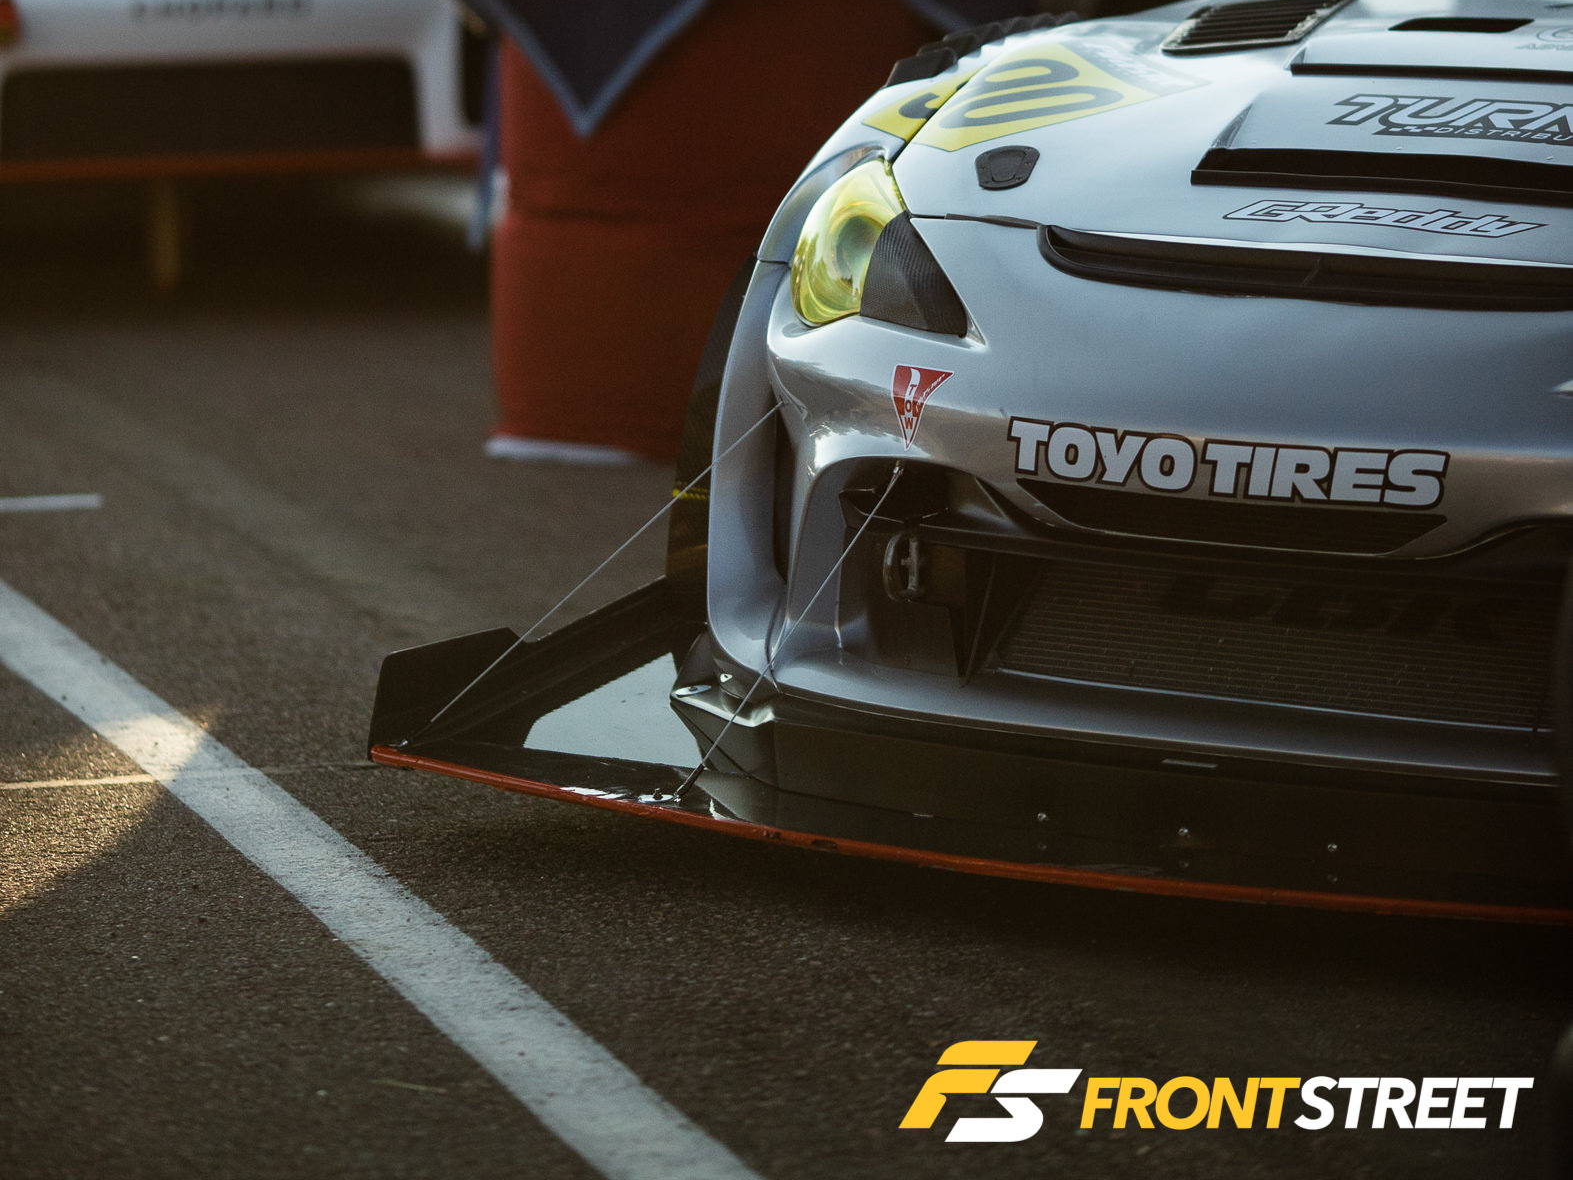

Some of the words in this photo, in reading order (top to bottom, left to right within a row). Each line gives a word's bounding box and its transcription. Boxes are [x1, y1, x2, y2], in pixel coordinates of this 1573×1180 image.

[903, 384, 918, 430] TOW
[1008, 417, 1198, 493] TOYO
[1202, 440, 1449, 510] TIRES
